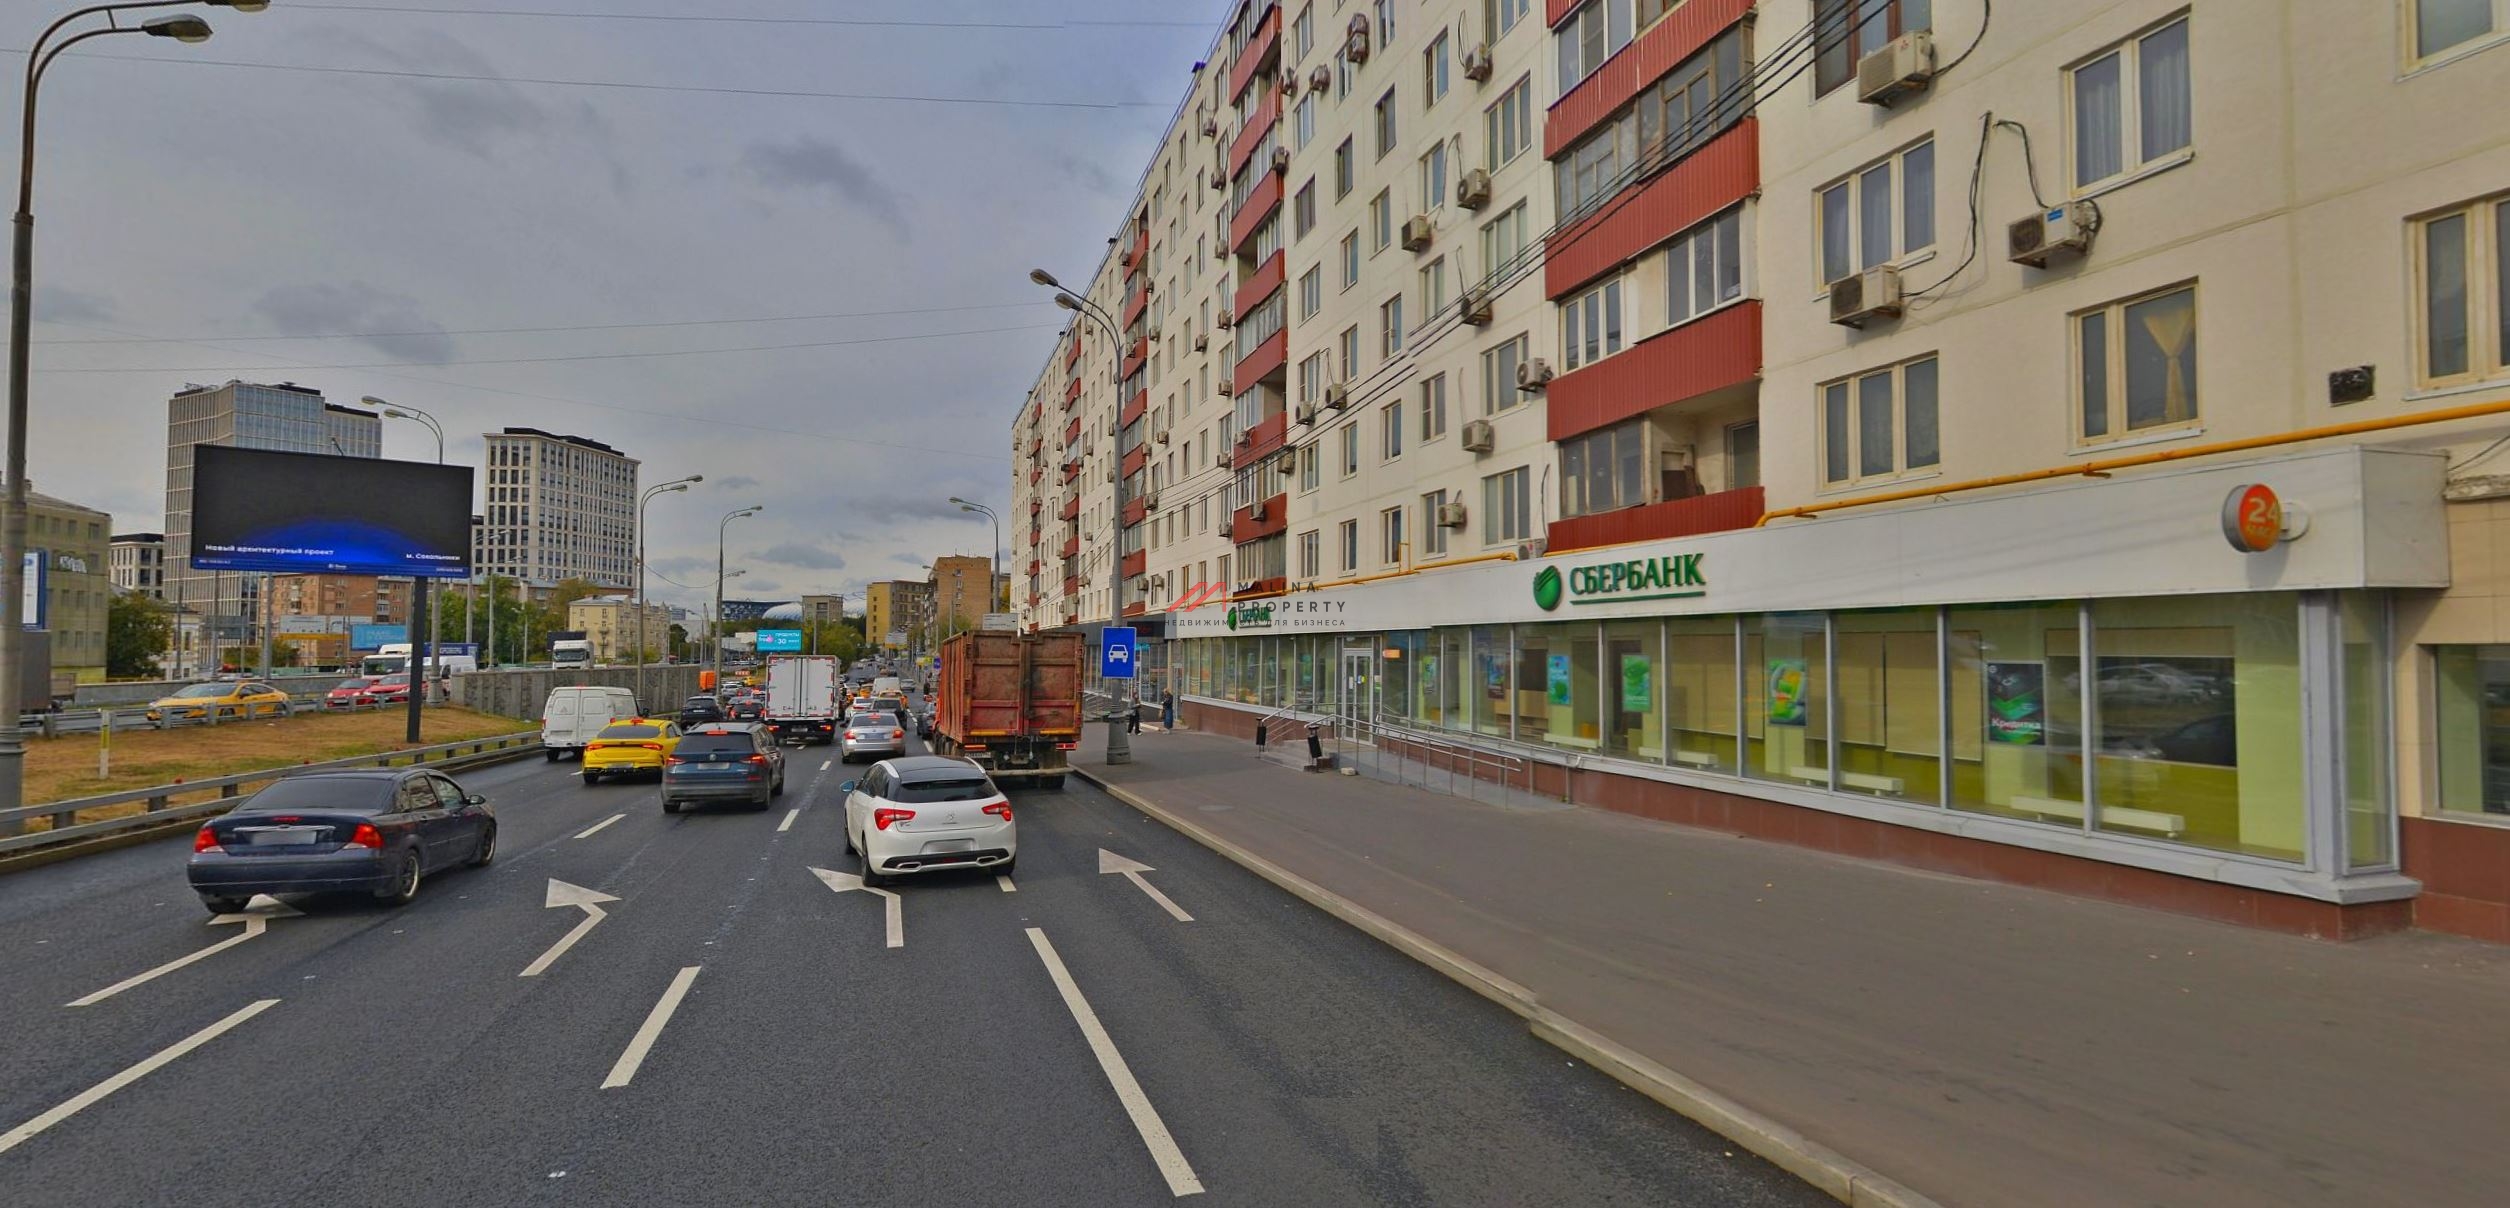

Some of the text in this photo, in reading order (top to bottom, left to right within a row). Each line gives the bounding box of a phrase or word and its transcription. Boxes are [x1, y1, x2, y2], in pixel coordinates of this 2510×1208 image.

[2248, 497, 2280, 526] 24
[237, 546, 303, 555] архитектурный
[1569, 553, 1706, 595] СБЕРБАНК
